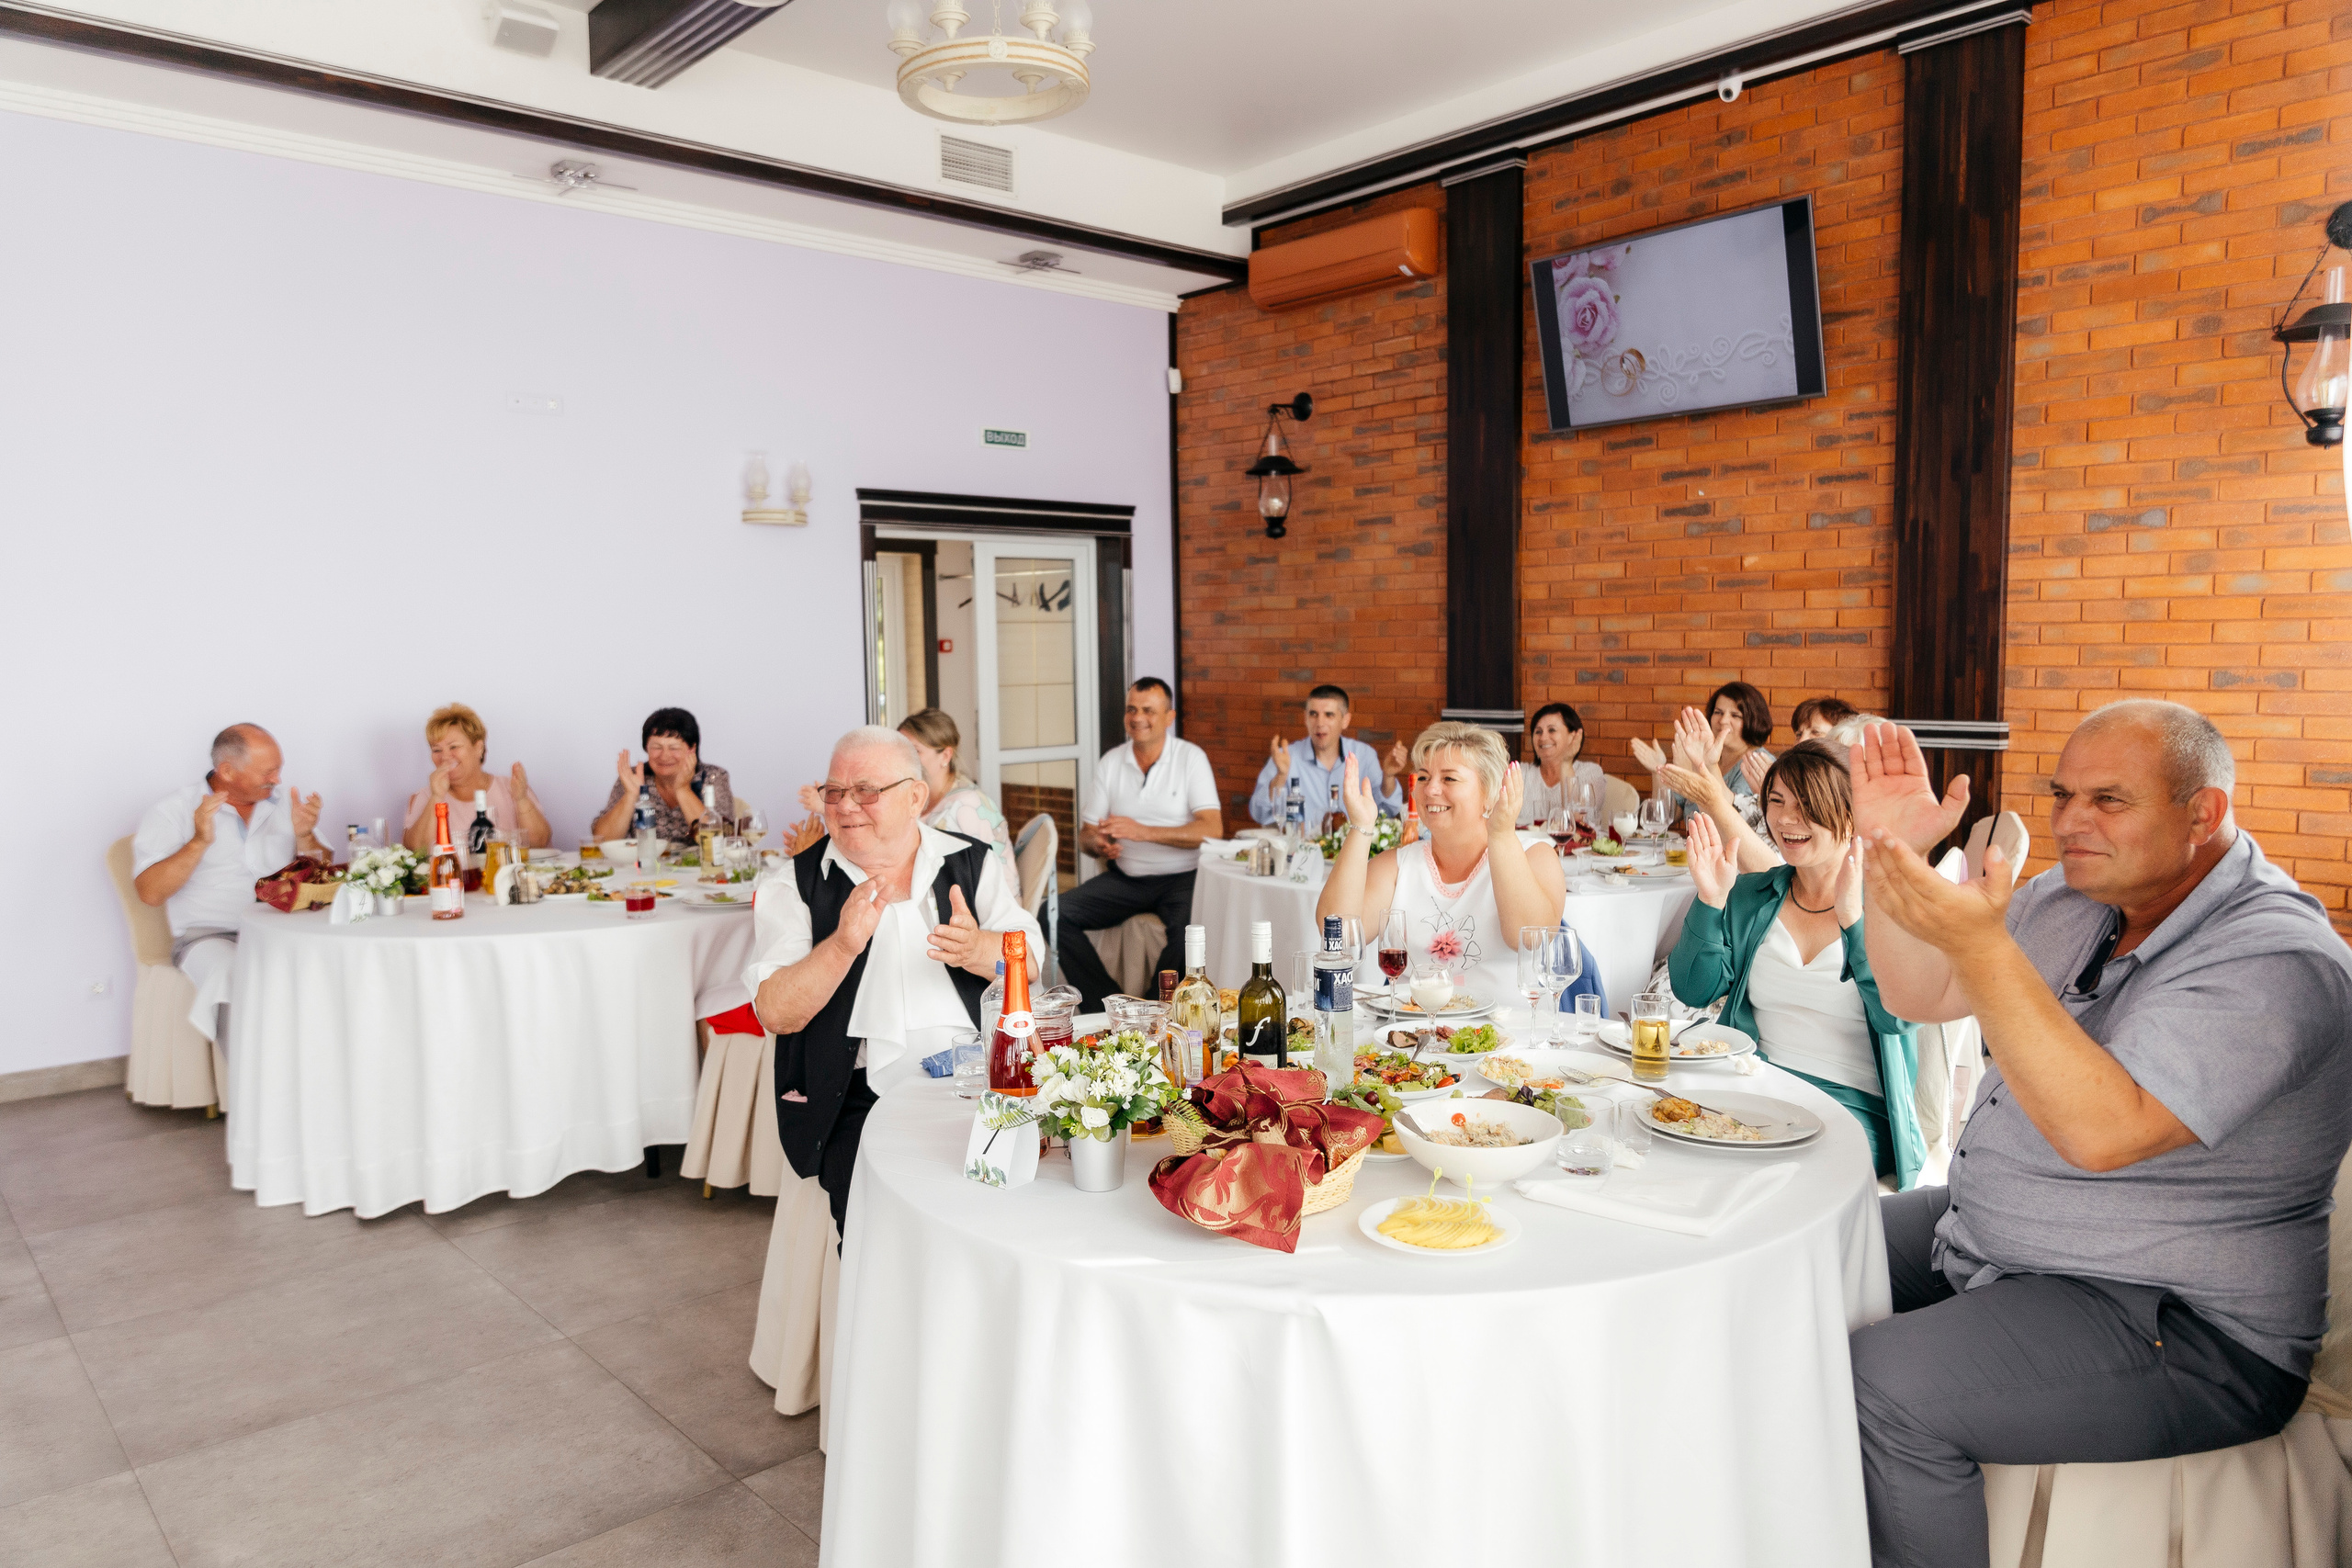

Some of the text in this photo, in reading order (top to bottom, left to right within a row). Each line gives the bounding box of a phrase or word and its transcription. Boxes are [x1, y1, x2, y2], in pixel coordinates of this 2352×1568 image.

[987, 431, 1025, 446] ВЫХОД
[1296, 854, 1308, 872] 2
[358, 891, 368, 910] 4
[1245, 1016, 1272, 1047] f
